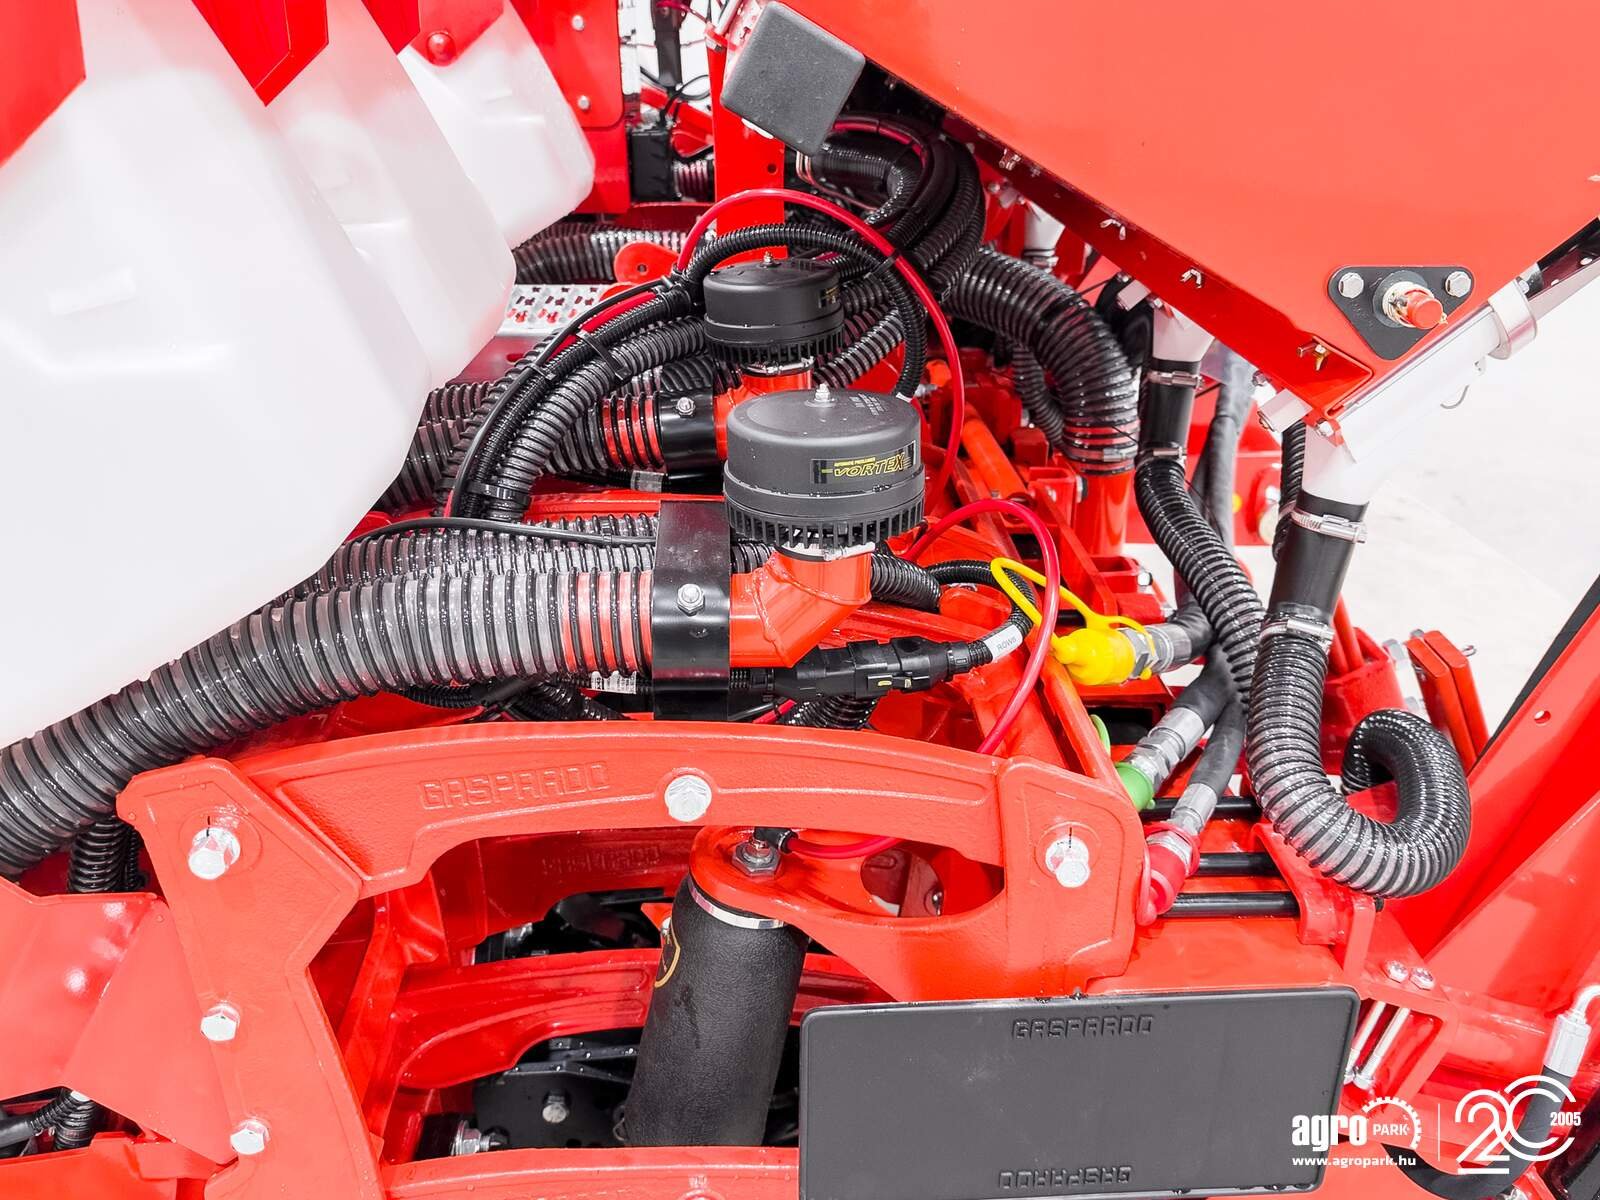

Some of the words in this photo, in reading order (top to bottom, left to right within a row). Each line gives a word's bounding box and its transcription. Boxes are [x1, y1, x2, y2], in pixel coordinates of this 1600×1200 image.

[834, 453, 905, 477] VORTEX
[420, 761, 609, 810] GASPARDO
[1012, 1014, 1154, 1039] GASPARDO
[999, 1165, 1132, 1190] GASPARDO
